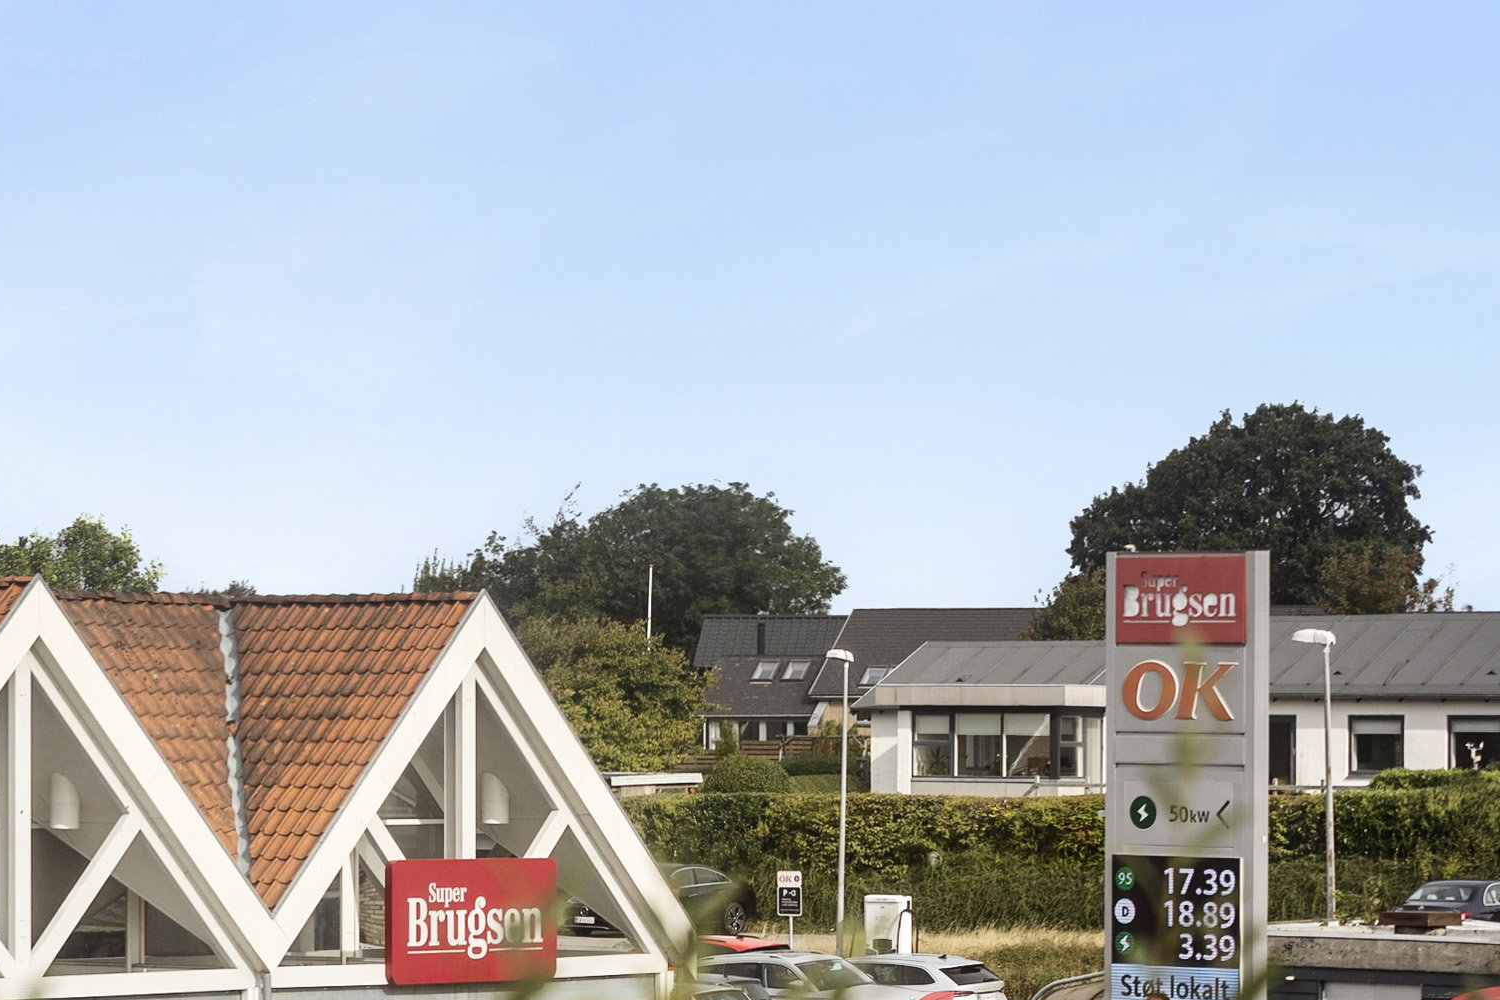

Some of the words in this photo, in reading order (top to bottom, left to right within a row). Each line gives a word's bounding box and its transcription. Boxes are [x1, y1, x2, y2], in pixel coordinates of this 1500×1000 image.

[1140, 571, 1180, 589] Super
[1123, 584, 1236, 627] Brugsen
[1122, 659, 1239, 722] OK
[428, 883, 467, 908] Super
[1117, 872, 1133, 886] 95
[1163, 867, 1236, 896] 17.39
[407, 896, 543, 960] Brugsen
[1121, 905, 1129, 917] D
[1163, 900, 1236, 929] 18.89
[1178, 933, 1236, 962] 3.39
[1170, 975, 1229, 1000] lokalt
